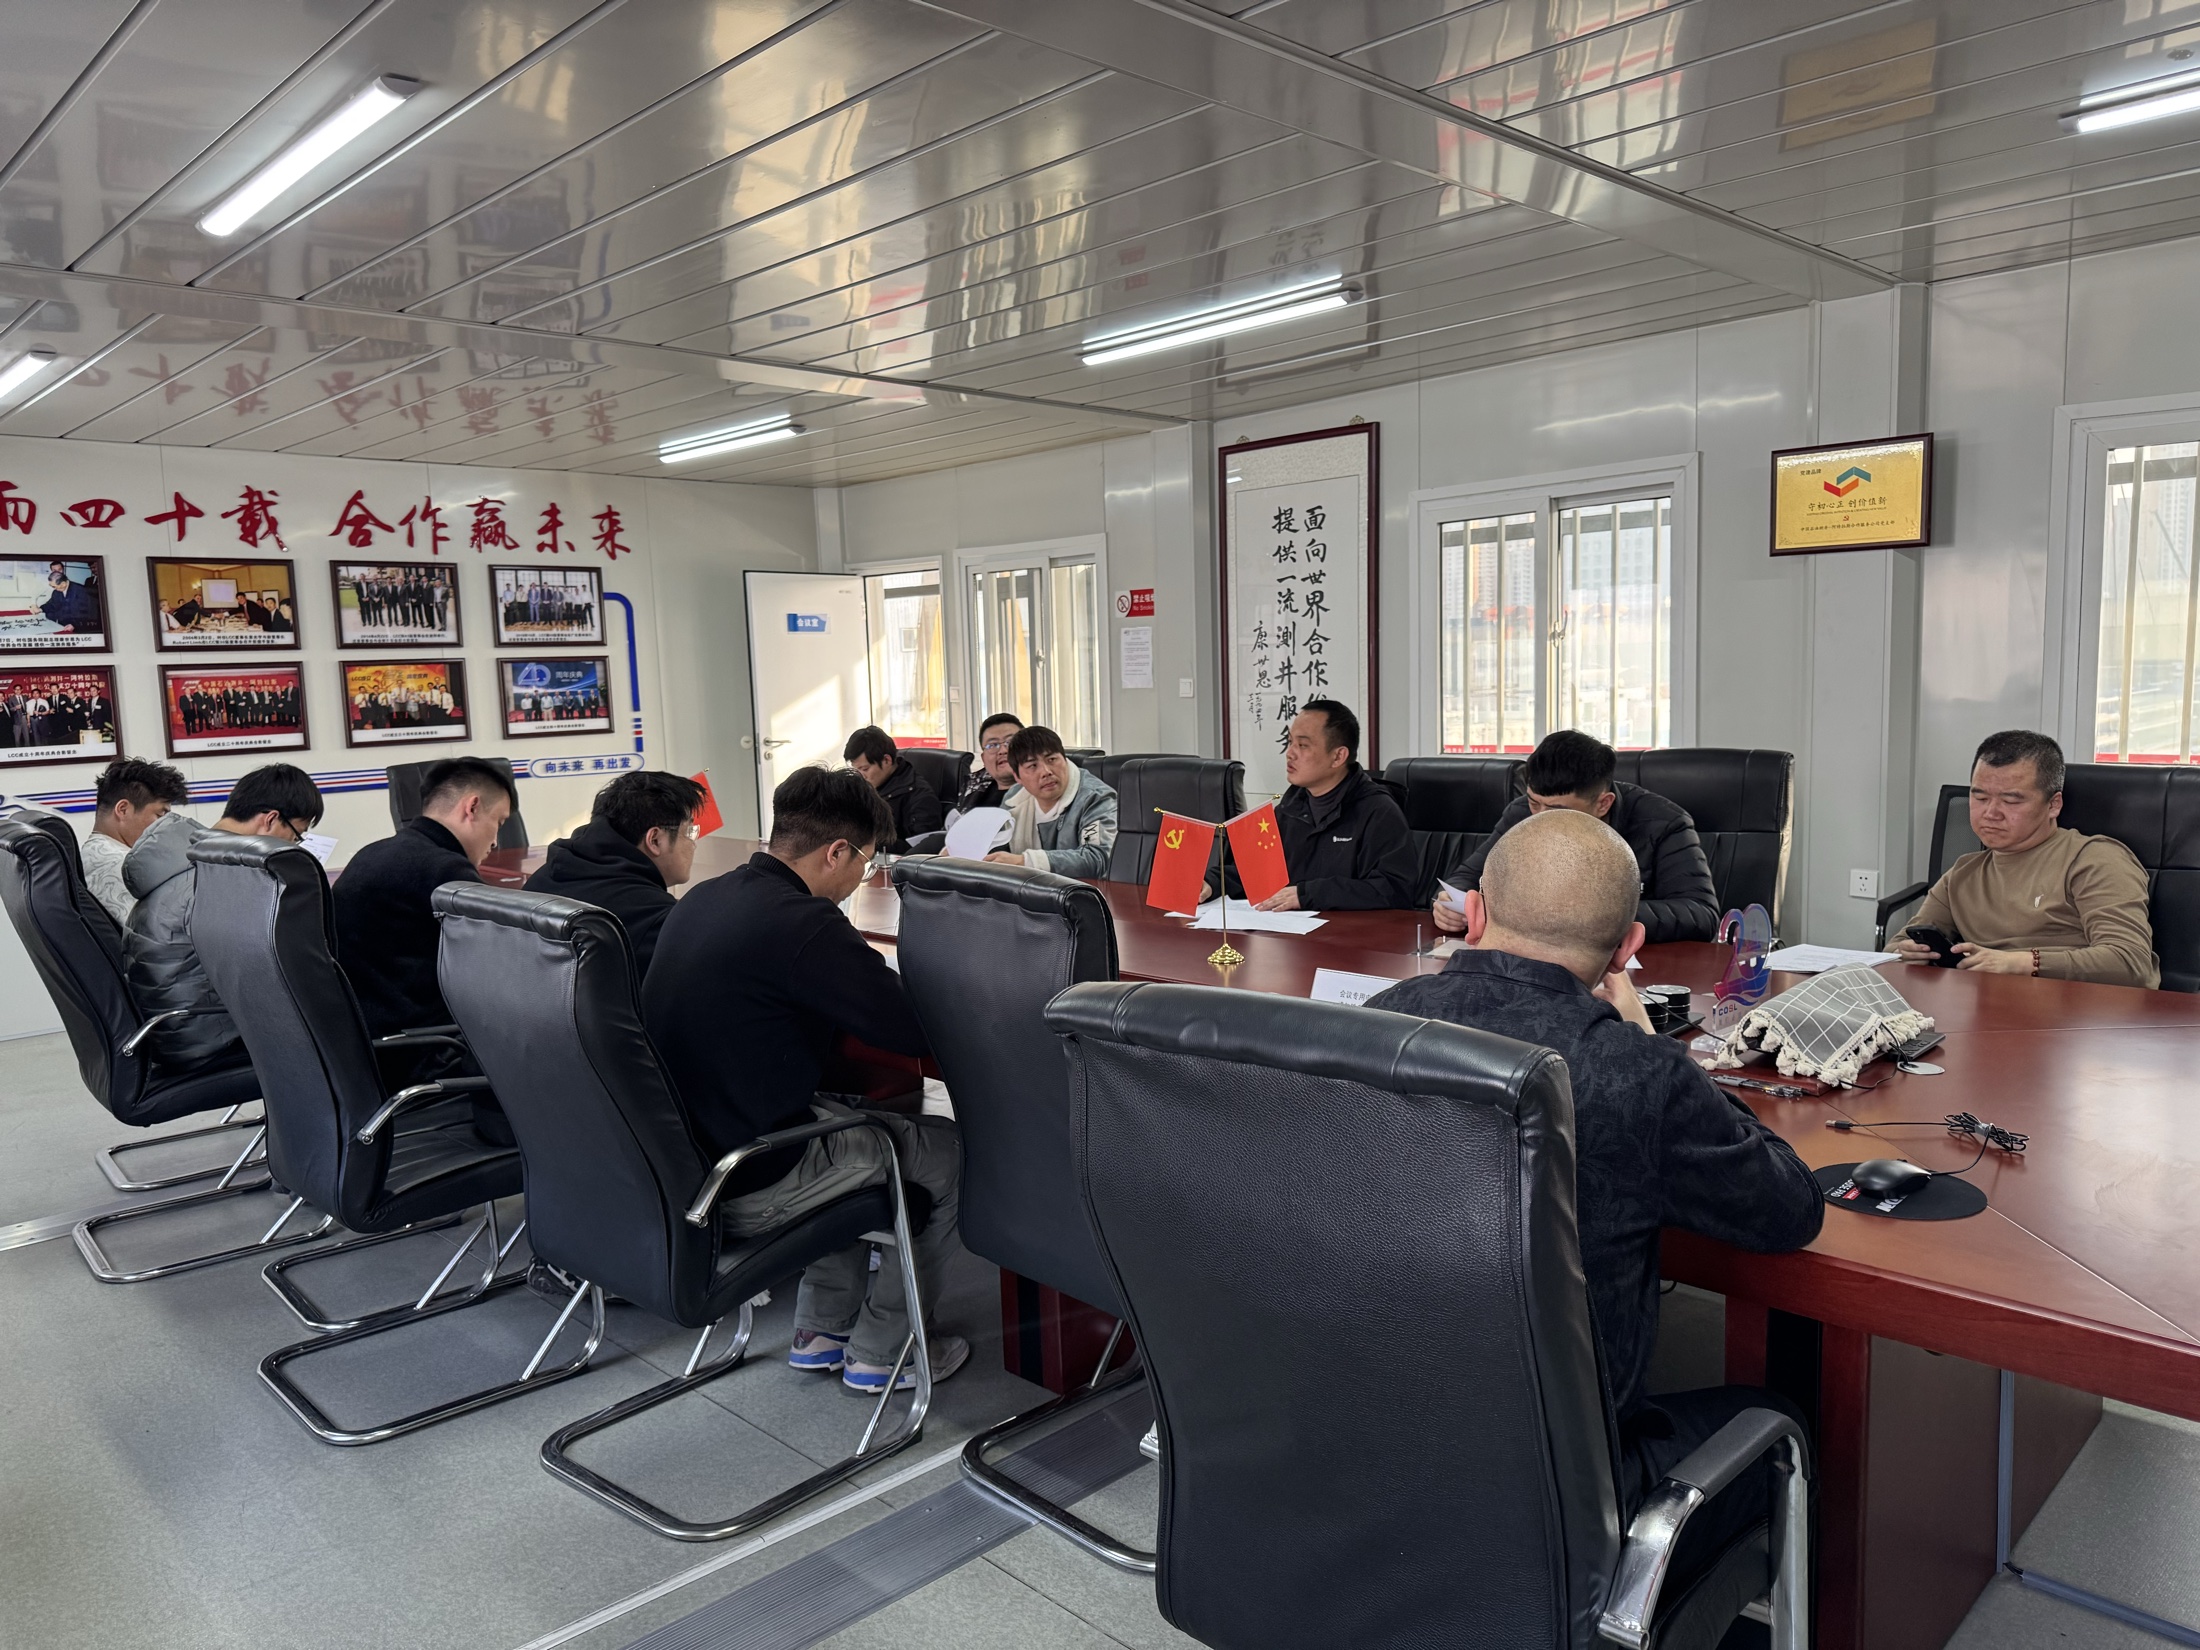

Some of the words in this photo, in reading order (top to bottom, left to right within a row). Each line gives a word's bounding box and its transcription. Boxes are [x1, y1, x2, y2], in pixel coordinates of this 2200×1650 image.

[328, 489, 631, 560] 合作赢未来
[797, 618, 819, 627] 会议室
[545, 760, 584, 773] 向未来
[593, 757, 631, 770] 再出发
[1719, 1003, 1737, 1015] COSL
